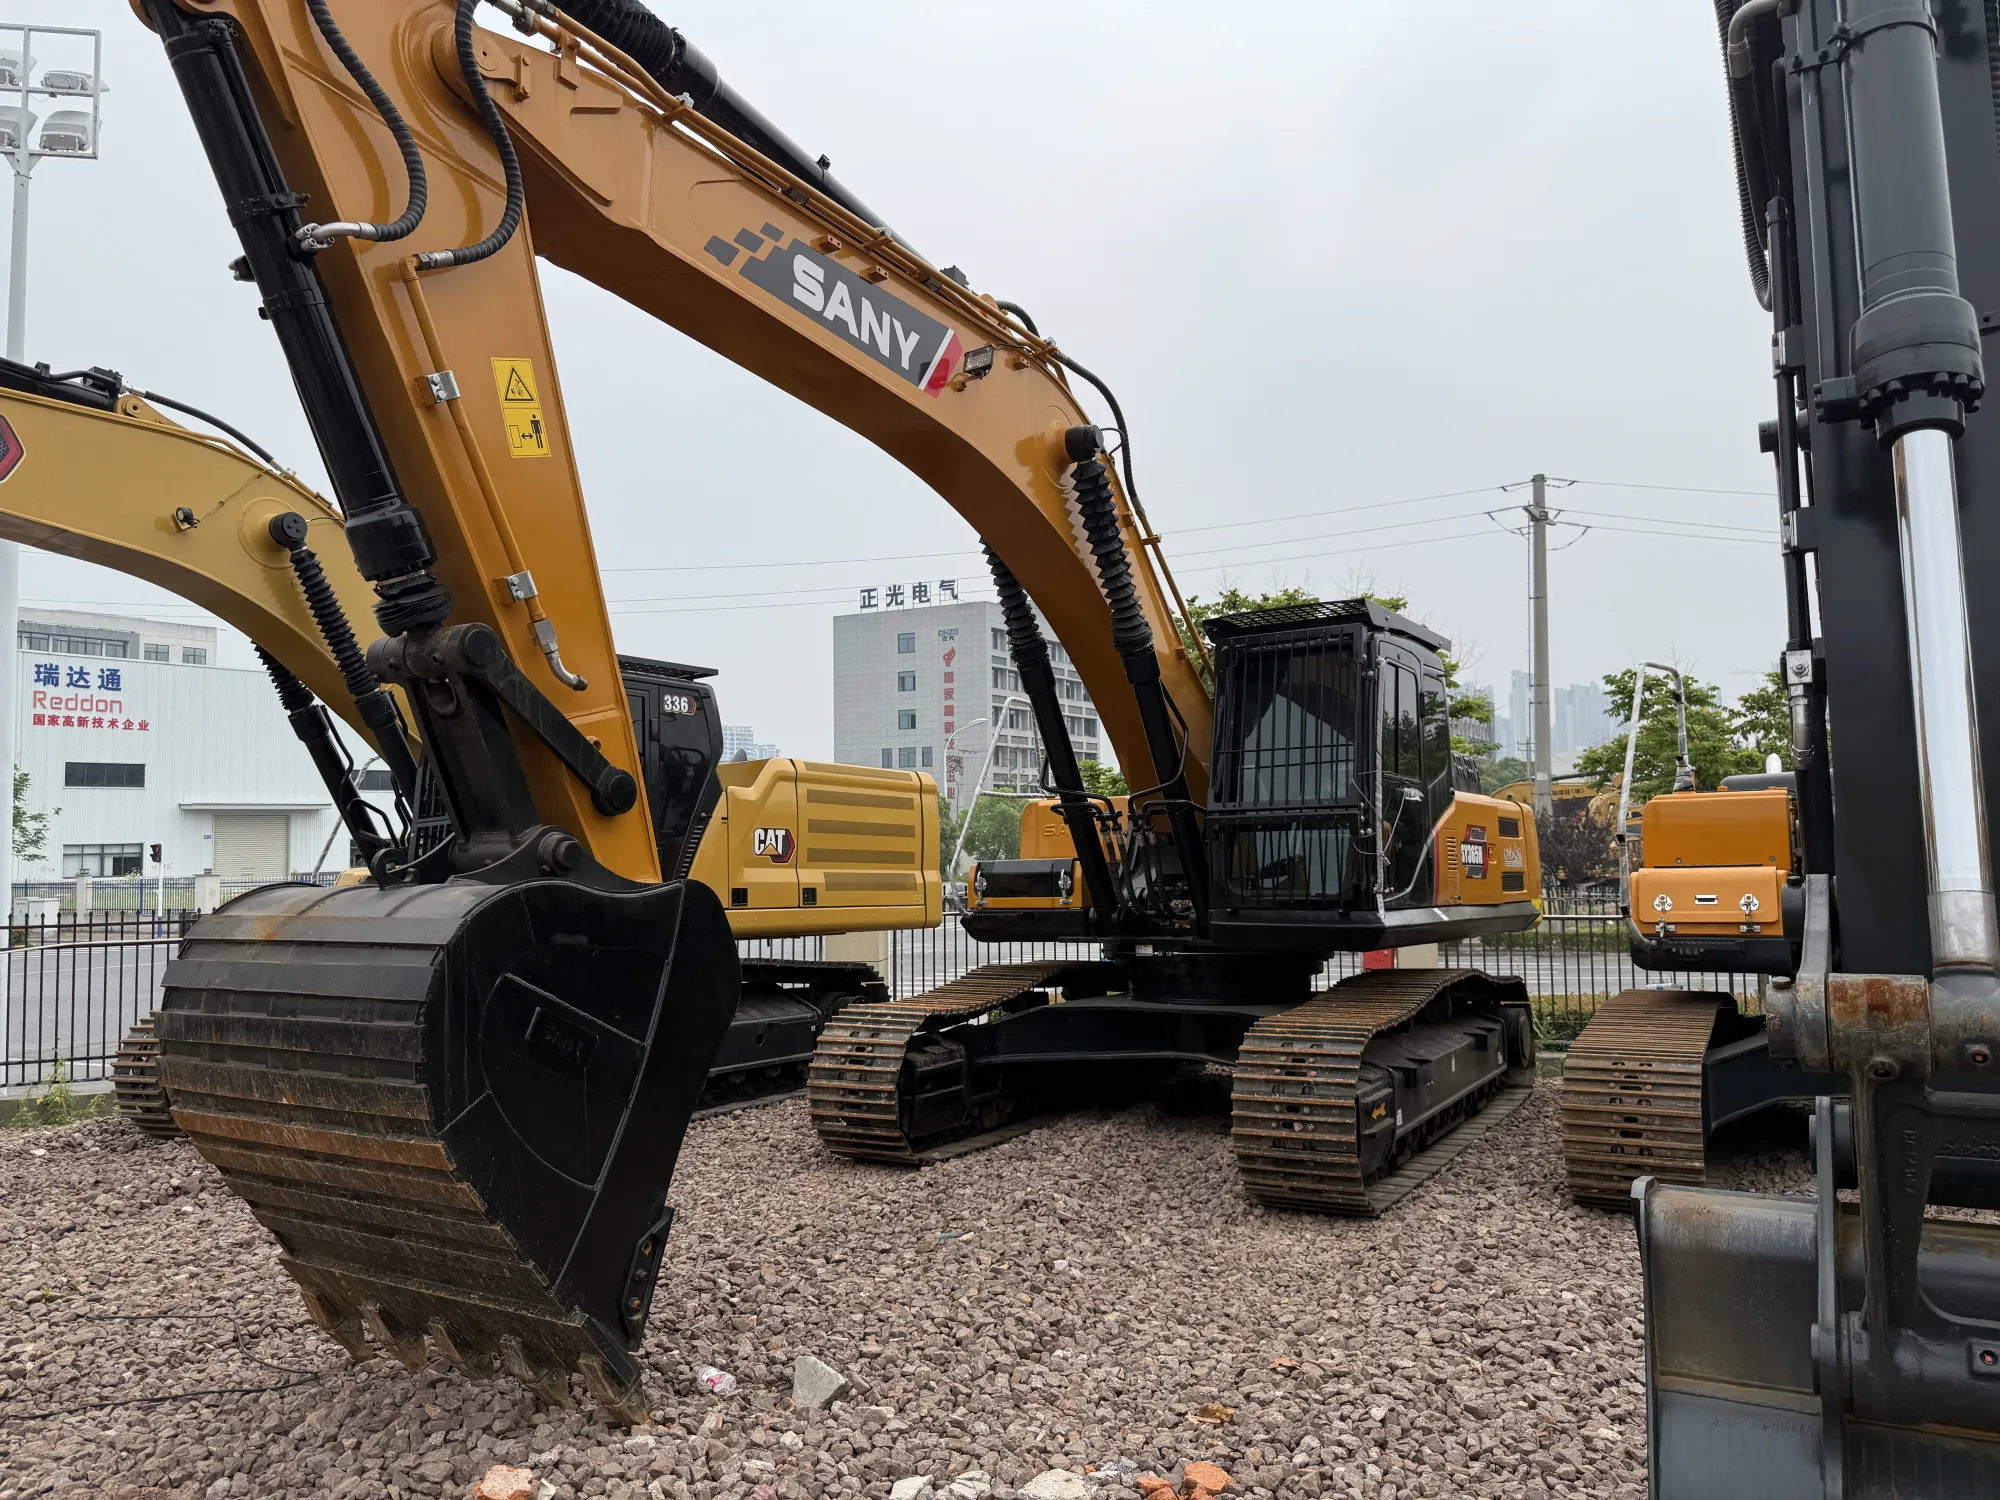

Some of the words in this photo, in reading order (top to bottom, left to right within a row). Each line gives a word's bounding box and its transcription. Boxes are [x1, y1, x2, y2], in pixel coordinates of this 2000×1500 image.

[793, 254, 920, 370] SANY
[860, 579, 958, 609] 正光电气
[34, 663, 122, 691] 瑞达通
[33, 690, 123, 713] Reddon
[664, 694, 689, 712] 336
[33, 714, 150, 731] 国家高新技术企业
[754, 828, 786, 856] CAT
